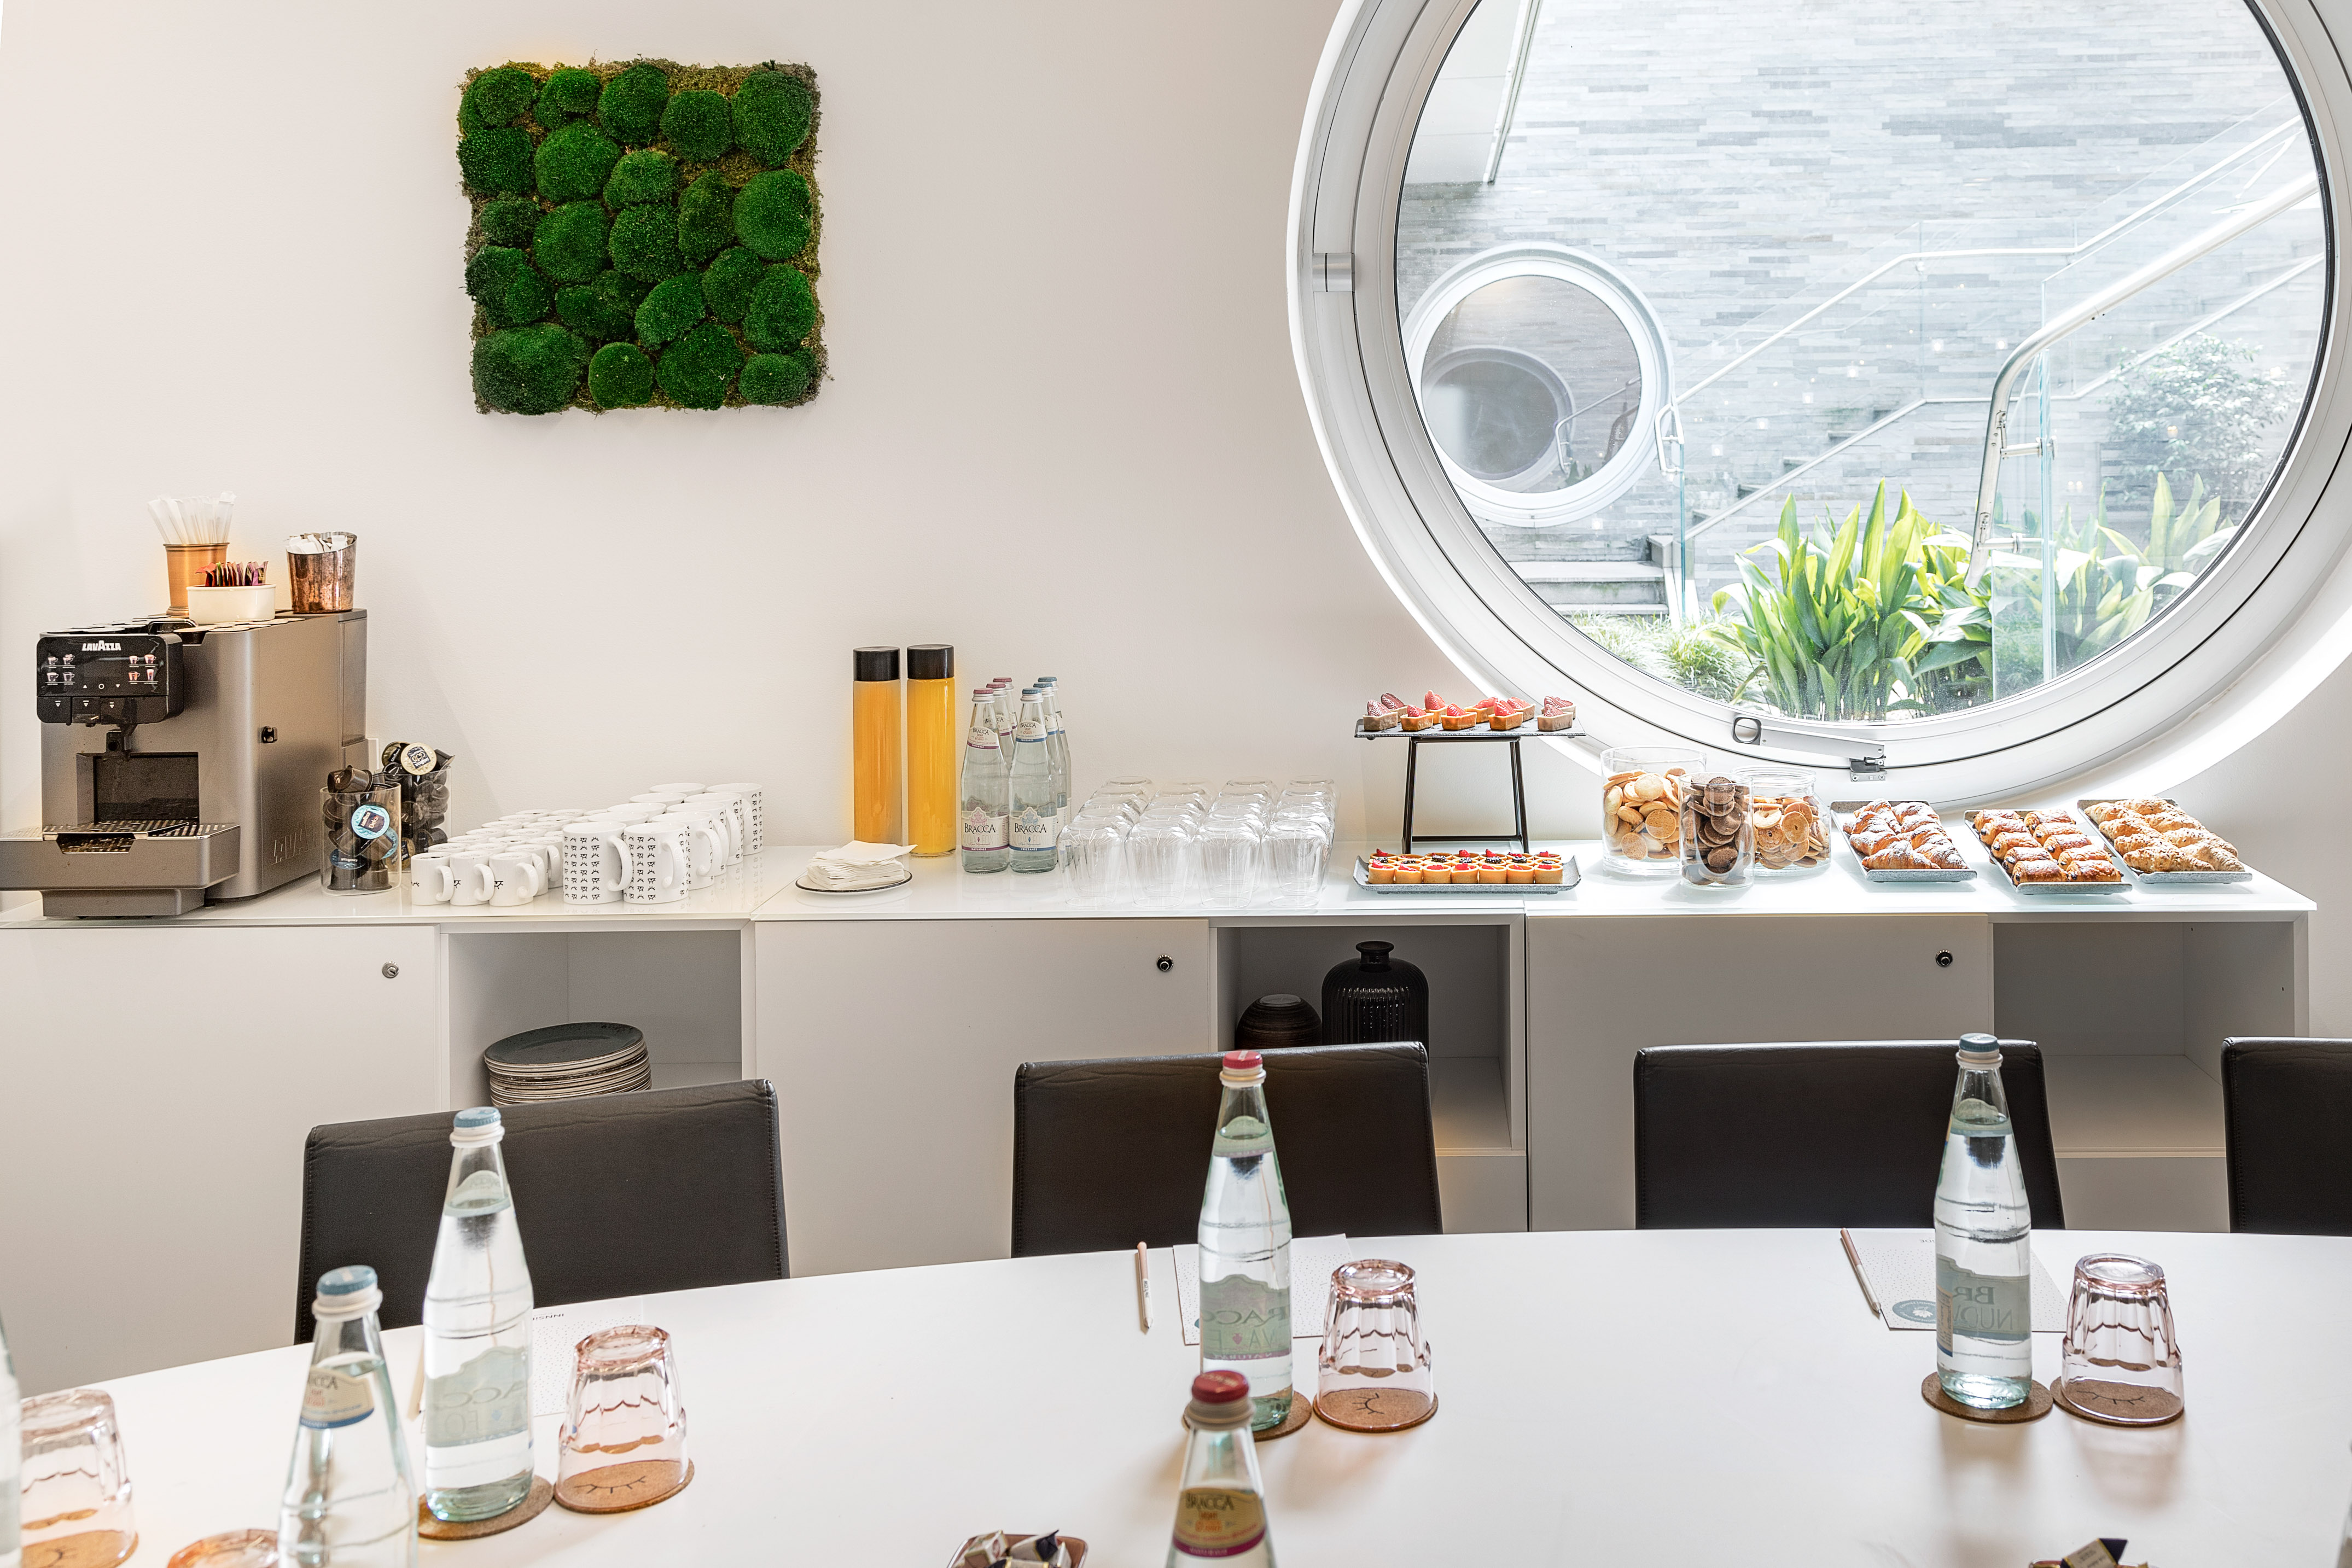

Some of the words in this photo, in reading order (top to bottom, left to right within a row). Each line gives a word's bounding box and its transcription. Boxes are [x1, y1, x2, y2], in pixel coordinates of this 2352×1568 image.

[82, 640, 121, 651] LAVAZZA
[964, 823, 996, 834] BRACCA
[1015, 823, 1047, 834] BRACCA
